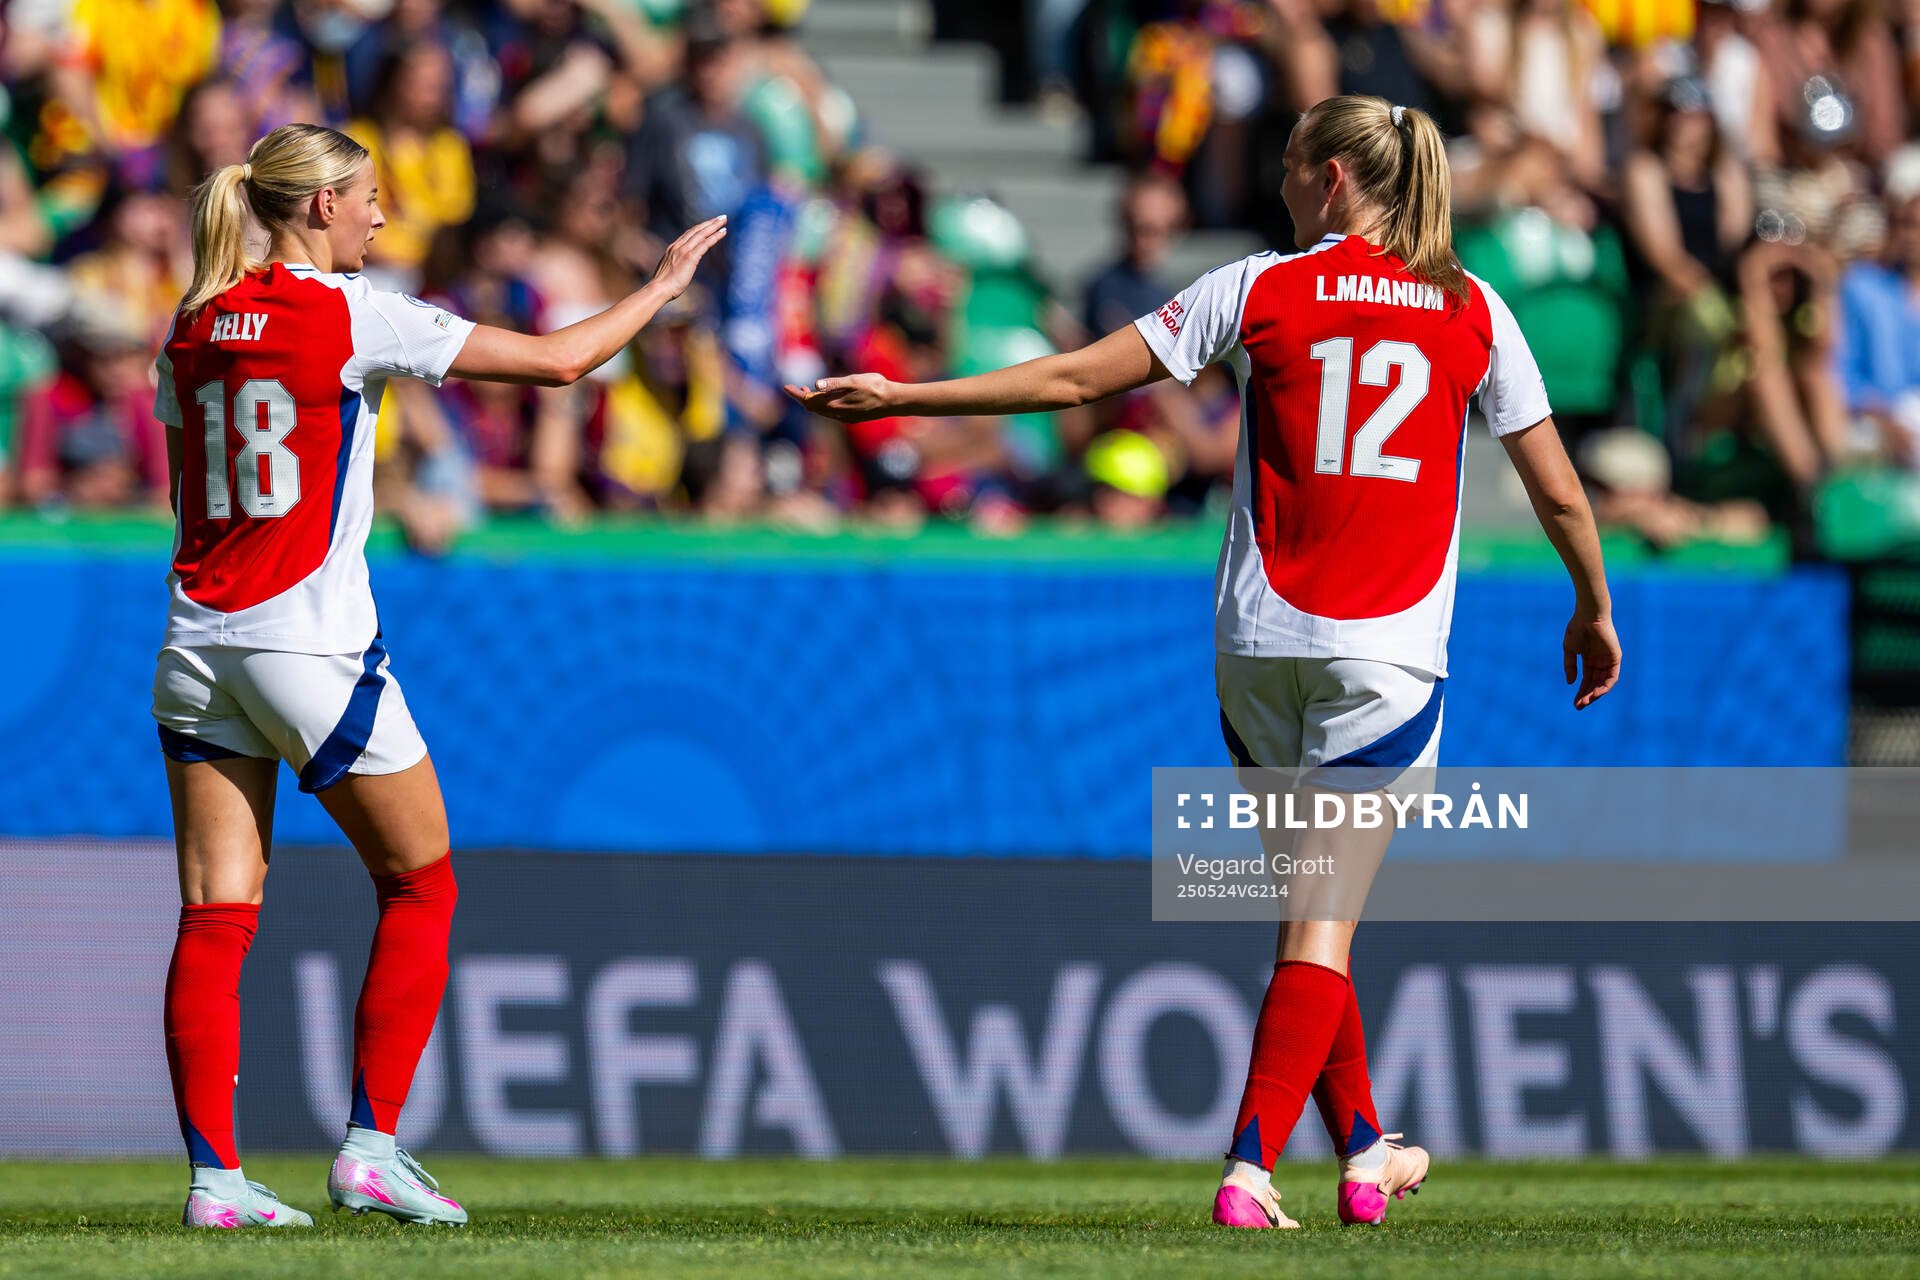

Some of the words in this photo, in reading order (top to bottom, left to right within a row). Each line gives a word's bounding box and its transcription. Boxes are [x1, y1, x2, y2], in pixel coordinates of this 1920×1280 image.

[210, 312, 269, 342] KELLY
[1316, 274, 1444, 311] L.MAANUM
[195, 379, 300, 519] 18
[1310, 337, 1431, 483] 12
[294, 952, 843, 1160] UEFA
